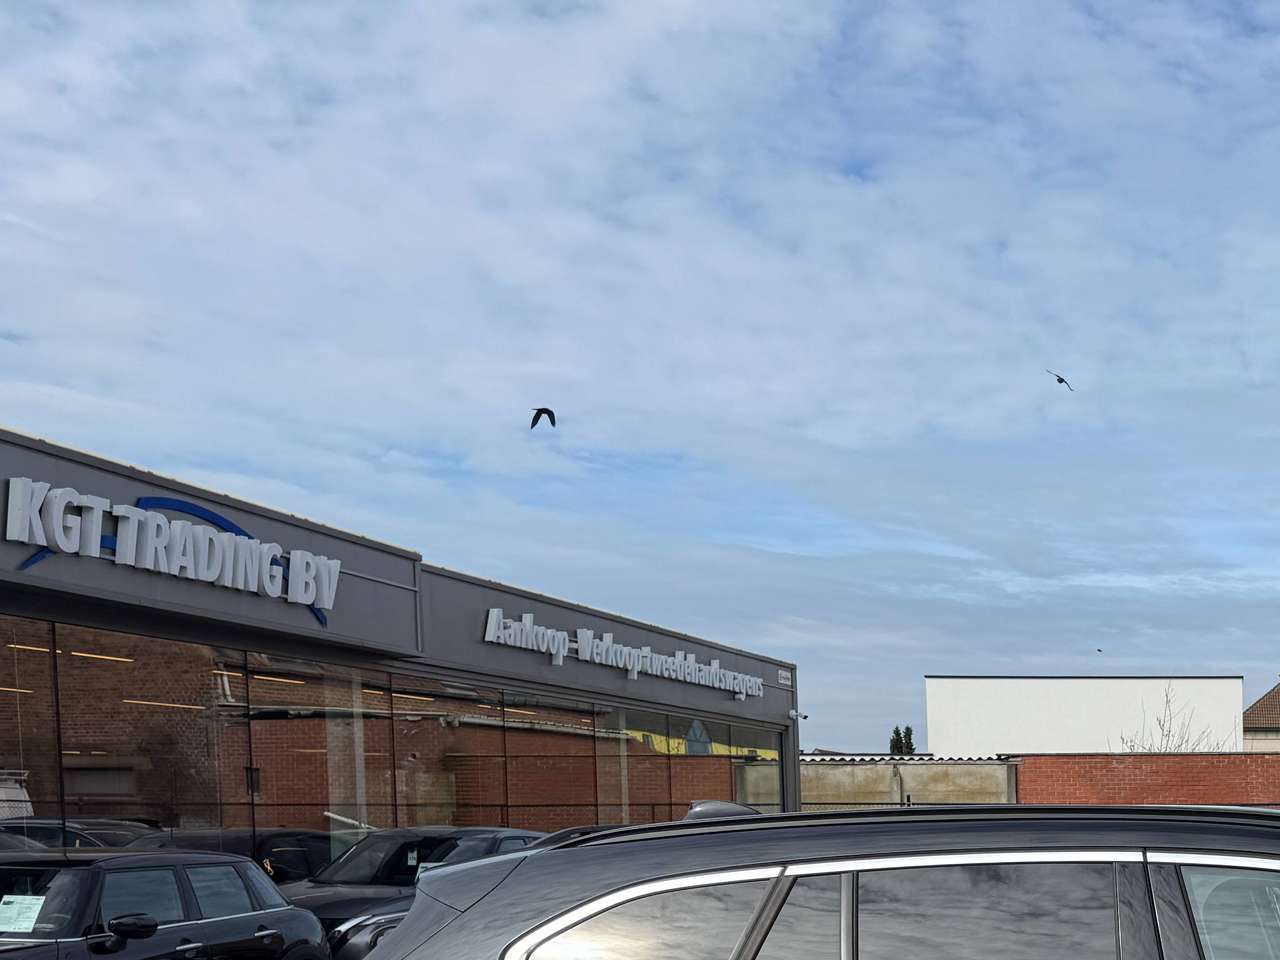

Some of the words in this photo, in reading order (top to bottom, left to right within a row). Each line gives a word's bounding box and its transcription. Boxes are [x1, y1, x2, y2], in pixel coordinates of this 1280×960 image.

[6, 477, 111, 558] KGT
[112, 504, 283, 598] TRADING
[288, 550, 341, 610] BV
[484, 608, 568, 666] Aankoop
